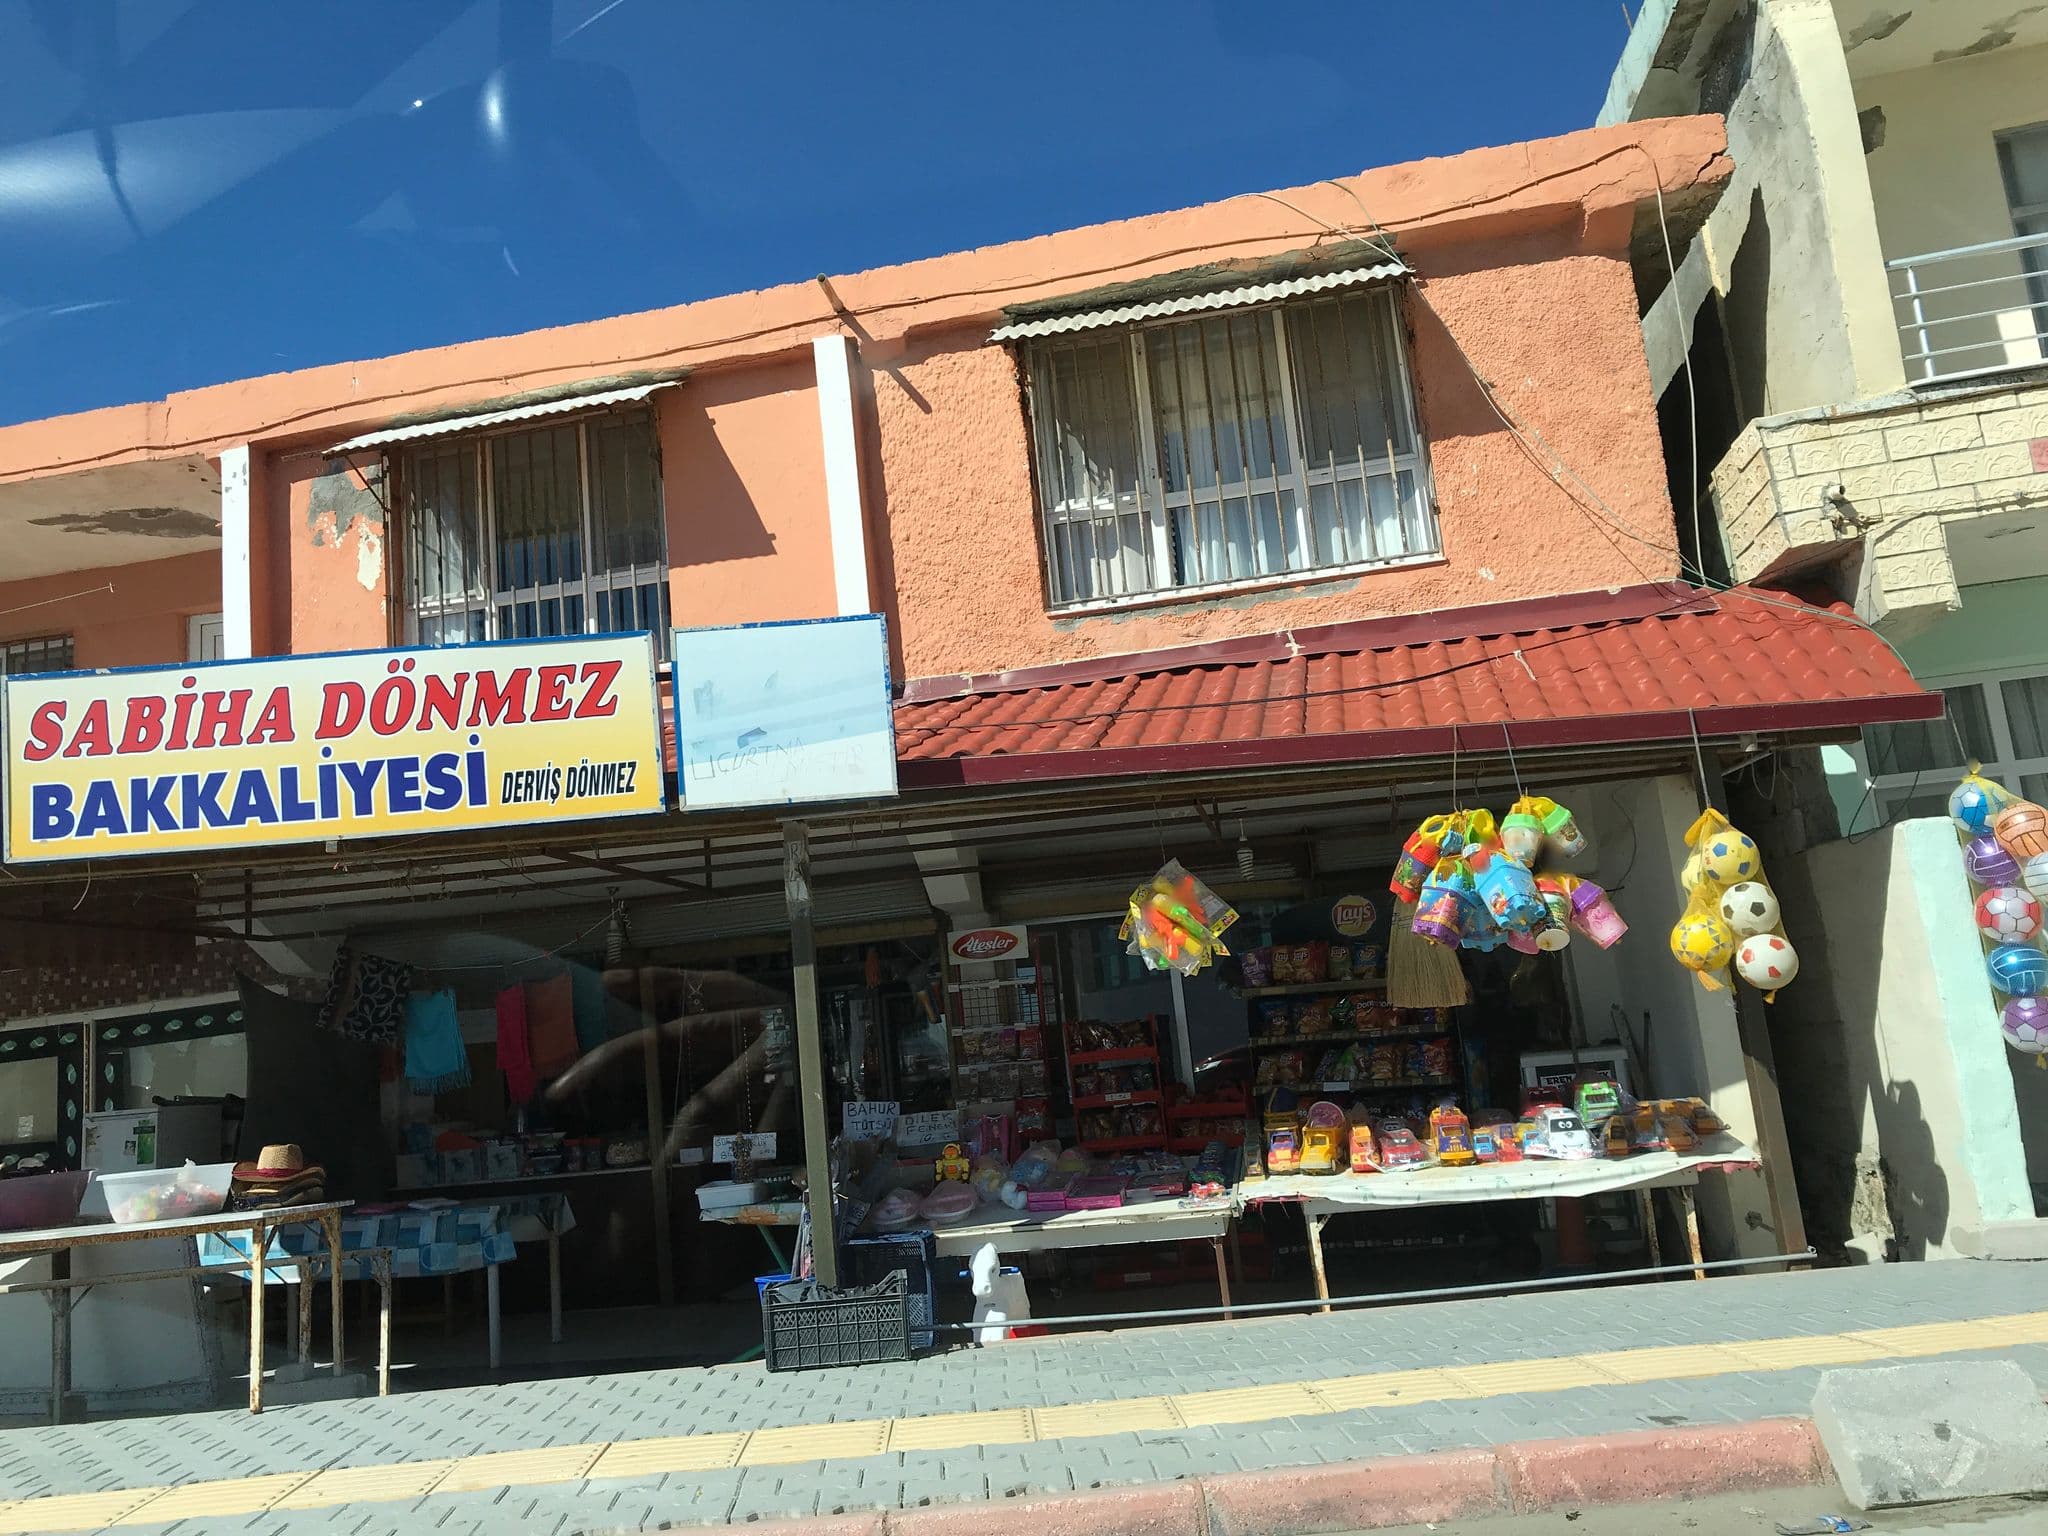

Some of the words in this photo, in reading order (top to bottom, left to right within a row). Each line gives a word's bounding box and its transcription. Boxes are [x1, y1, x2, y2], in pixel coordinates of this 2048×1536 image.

[24, 676, 295, 761] SABİHA
[314, 657, 622, 739] DÖNMEZ
[32, 734, 488, 840] BAKKALİYESİ
[501, 762, 561, 804] DERVİŞ
[565, 759, 637, 798] DÖNMEZ
[847, 1102, 896, 1117] BAHUR
